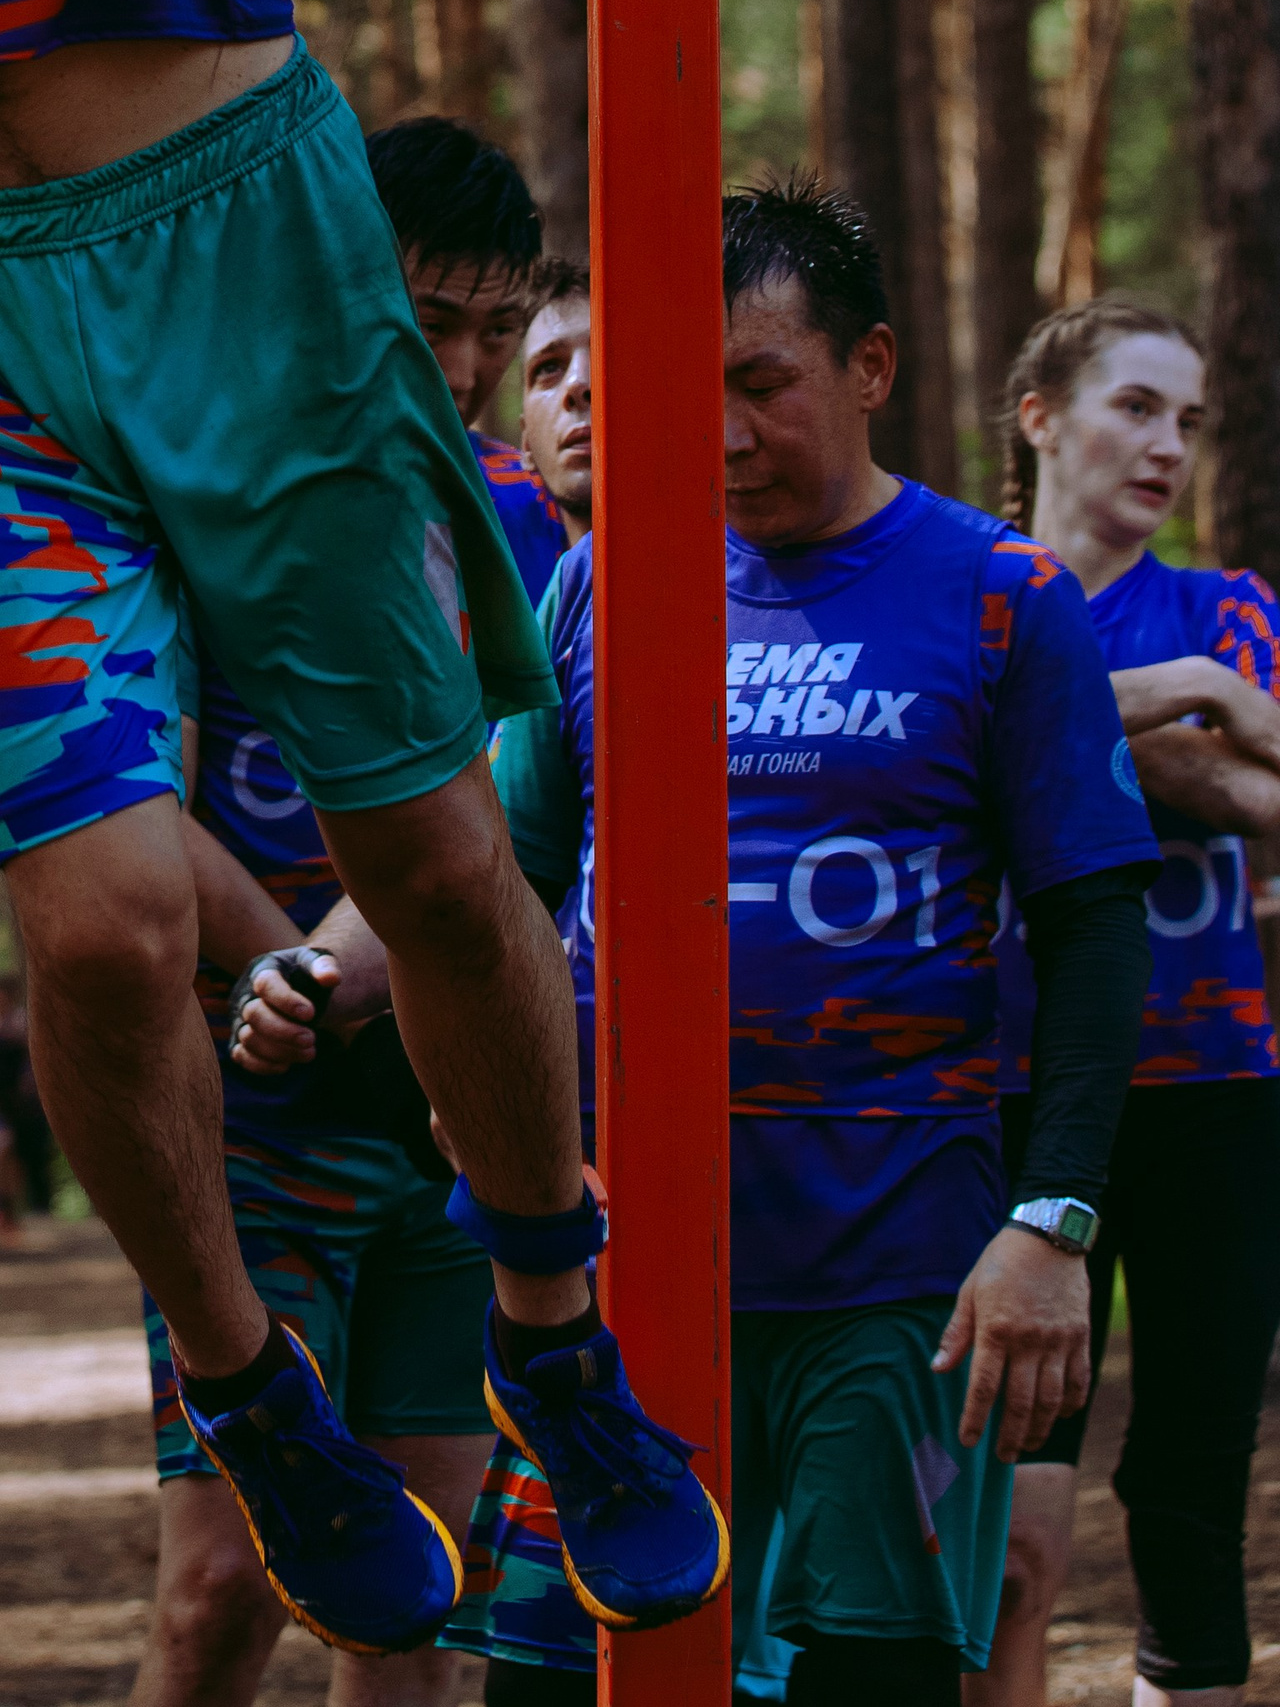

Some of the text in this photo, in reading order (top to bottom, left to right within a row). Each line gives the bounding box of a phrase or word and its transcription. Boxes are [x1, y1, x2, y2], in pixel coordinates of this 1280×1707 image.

[726, 642, 864, 685] ЕМЯ
[726, 685, 920, 740] ЬНЫХ
[756, 751, 821, 774] ГОНКА
[728, 835, 942, 947] -01
